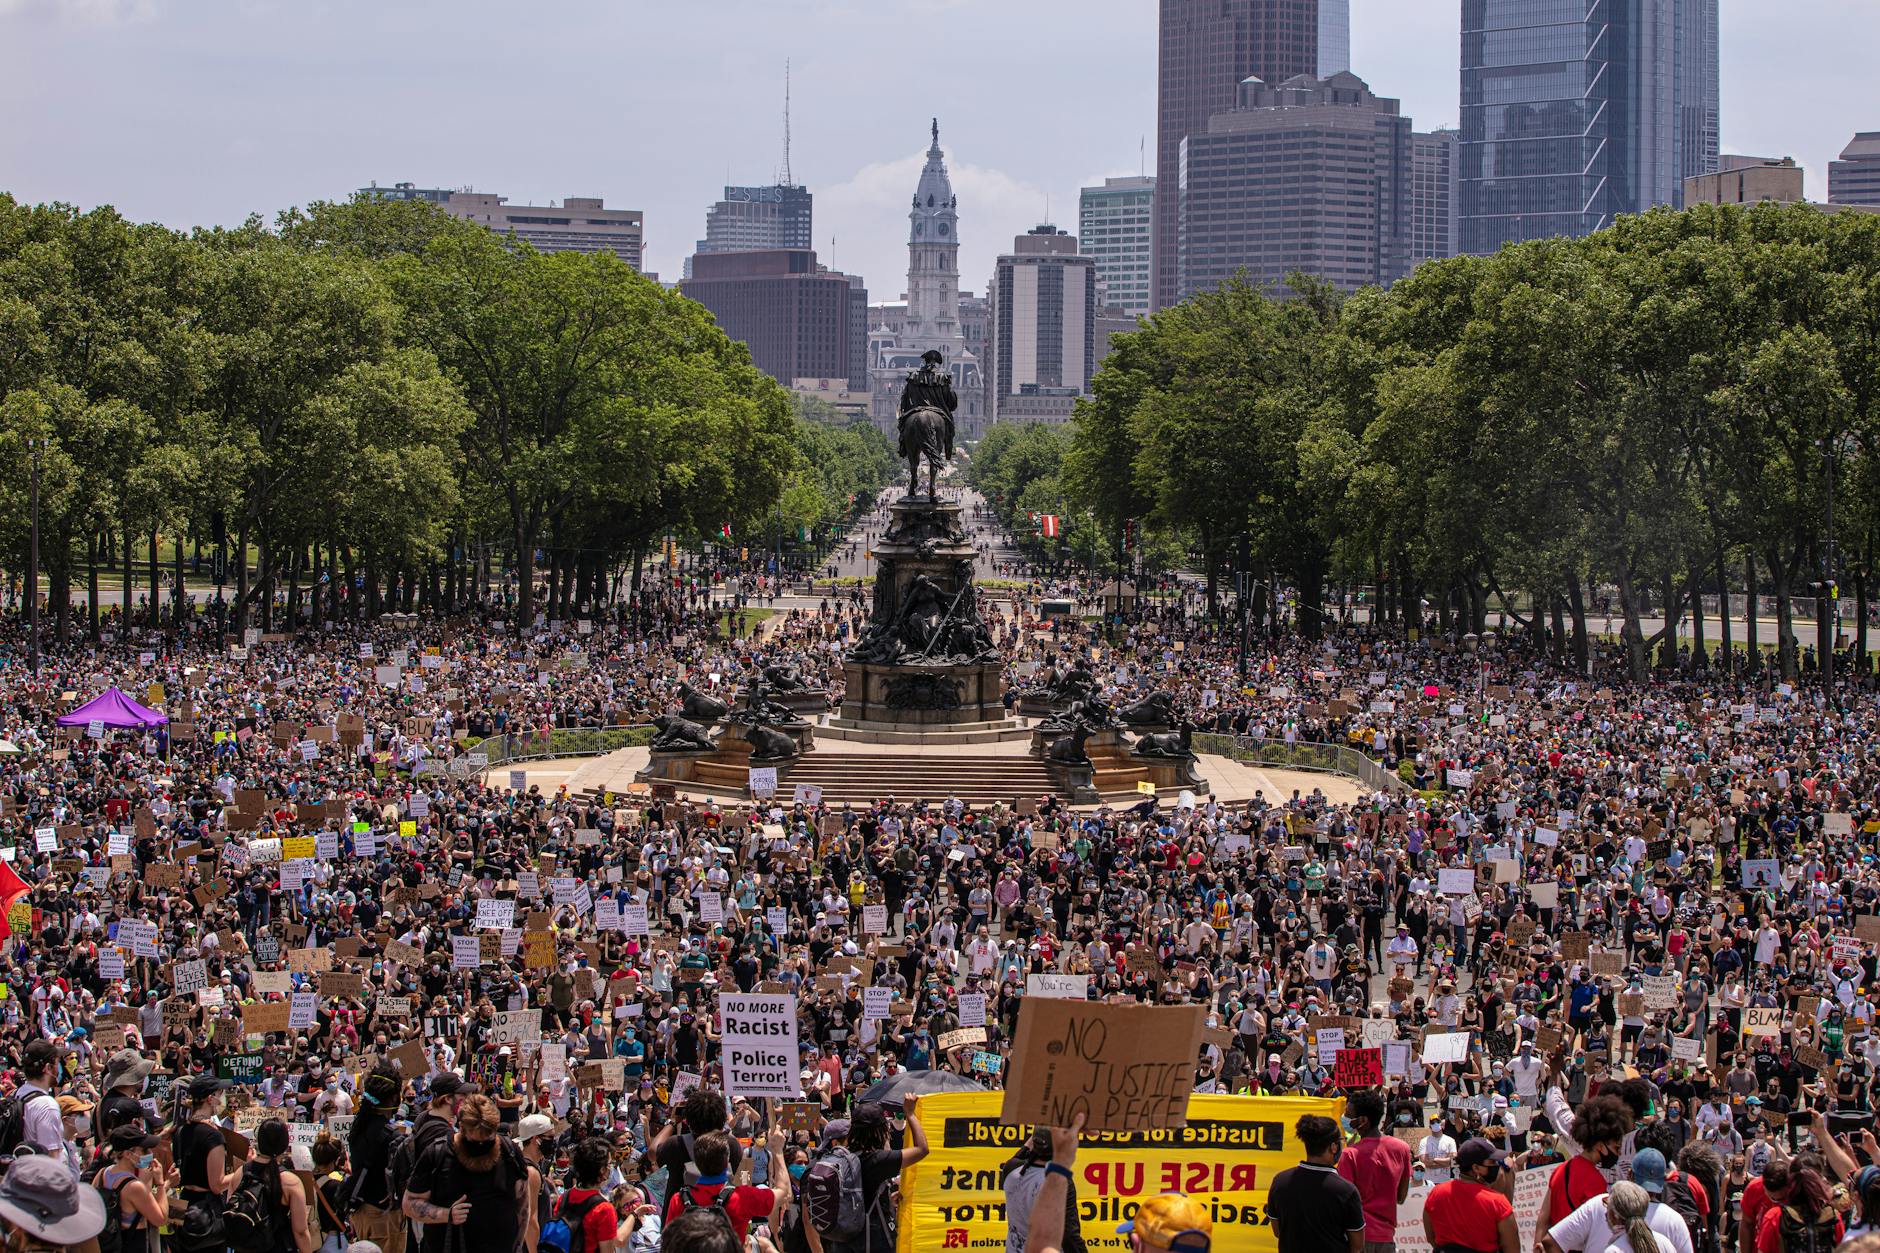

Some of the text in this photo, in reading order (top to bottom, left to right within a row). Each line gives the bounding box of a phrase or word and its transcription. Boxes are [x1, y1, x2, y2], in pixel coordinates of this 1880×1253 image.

[728, 187, 783, 203] PSFS
[407, 719, 432, 736] BLM
[479, 900, 514, 909] GET YOUR
[478, 909, 513, 917] KNEE OFF
[474, 917, 513, 928] THEIR NECK
[272, 922, 305, 949] BLM
[1834, 938, 1861, 947] #DEFUND
[1834, 946, 1845, 954] THE
[175, 961, 204, 976] BLACK
[177, 970, 206, 985] LIVES
[1038, 975, 1073, 992] You're
[176, 981, 208, 994] MATTER
[379, 998, 410, 1006] JUSTICE
[726, 1002, 785, 1014] NO MORE
[493, 1013, 540, 1026] NO JUSTICE
[1748, 1010, 1780, 1026] BLM
[424, 1017, 458, 1038] BLM
[725, 1017, 790, 1036] Racist
[492, 1023, 540, 1043] NO PEACE
[939, 1030, 960, 1041] BLACK
[1063, 1016, 1107, 1061] NO
[1372, 1030, 1388, 1040] BLM
[947, 1034, 982, 1045] MATTER
[223, 1056, 263, 1068] DEFUND
[471, 1053, 499, 1065] BLACK
[732, 1050, 788, 1067] Police
[975, 1051, 1001, 1062] BLACK
[1337, 1050, 1379, 1064] BLACK
[230, 1066, 254, 1077] THE
[471, 1063, 497, 1073] LIVES
[1337, 1062, 1369, 1074] LIVES
[469, 1072, 503, 1088] MATTER
[678, 1074, 699, 1084] WHITE
[731, 1069, 788, 1084] Terror!
[1083, 1061, 1192, 1099] JUSTICE
[1337, 1073, 1378, 1085] MATTER
[1051, 1094, 1184, 1130] NO PEACE
[299, 1123, 322, 1132] JUSTICE
